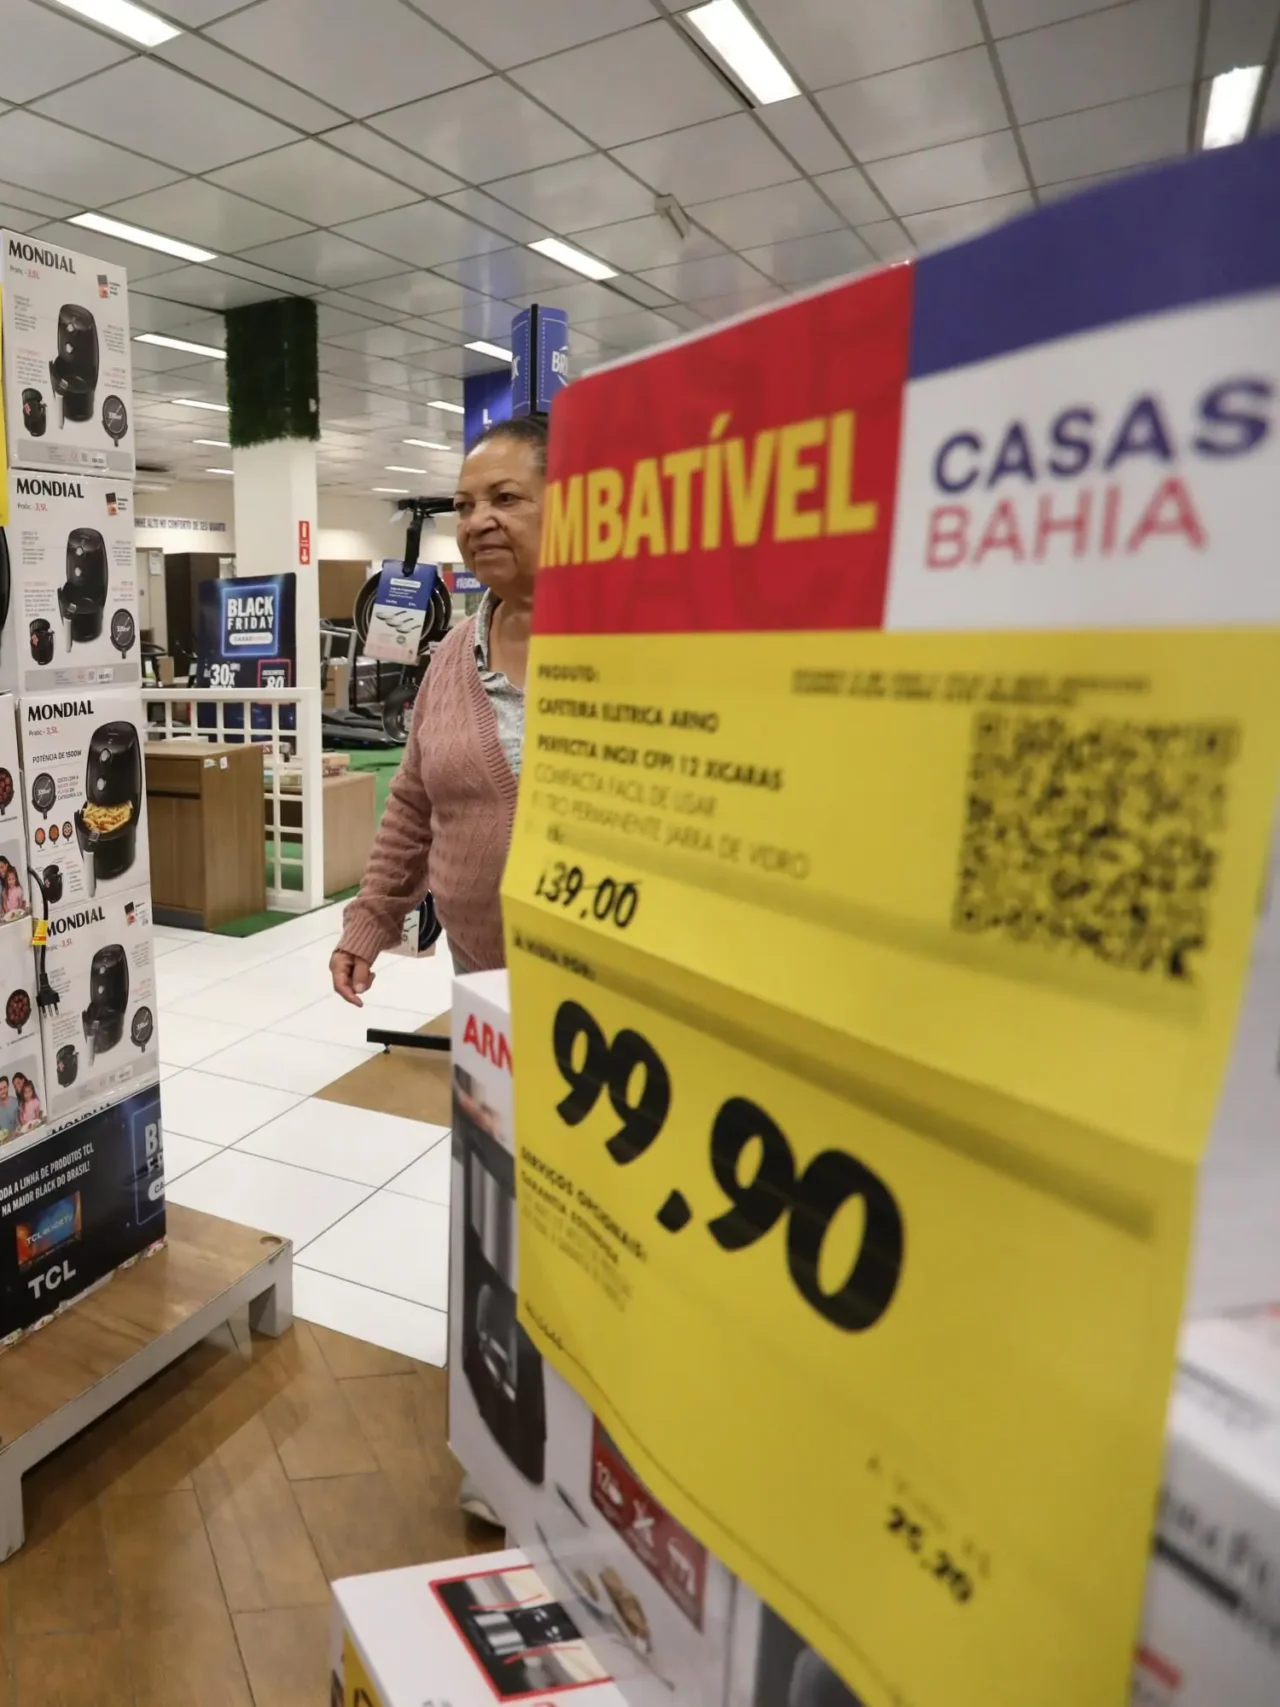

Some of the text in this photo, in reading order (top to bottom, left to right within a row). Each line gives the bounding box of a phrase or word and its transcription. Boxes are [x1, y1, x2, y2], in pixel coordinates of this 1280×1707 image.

[8, 239, 76, 275] MONDIAL
[932, 376, 1277, 496] CASAS
[16, 478, 84, 499] MONDIAL
[924, 476, 1208, 571] BAHIA
[227, 596, 273, 618] BLACK
[227, 616, 274, 631] FRIDAY
[28, 699, 94, 722] MONDIAL
[669, 710, 720, 734] ARNO
[32, 752, 58, 764] POTÊNCIA
[602, 743, 639, 767] INOX
[680, 755, 700, 777] 12
[46, 906, 106, 938] MONDIAL
[14, 1181, 19, 1194] A
[19, 1170, 40, 1191] LINHA
[40, 1165, 50, 1180] DE
[50, 1148, 83, 1174] PRODUTOS
[82, 1142, 94, 1157] TCL
[1, 1160, 91, 1218] NA MAIOR BLACK DO BRASIL!
[27, 1259, 77, 1300] TCL
